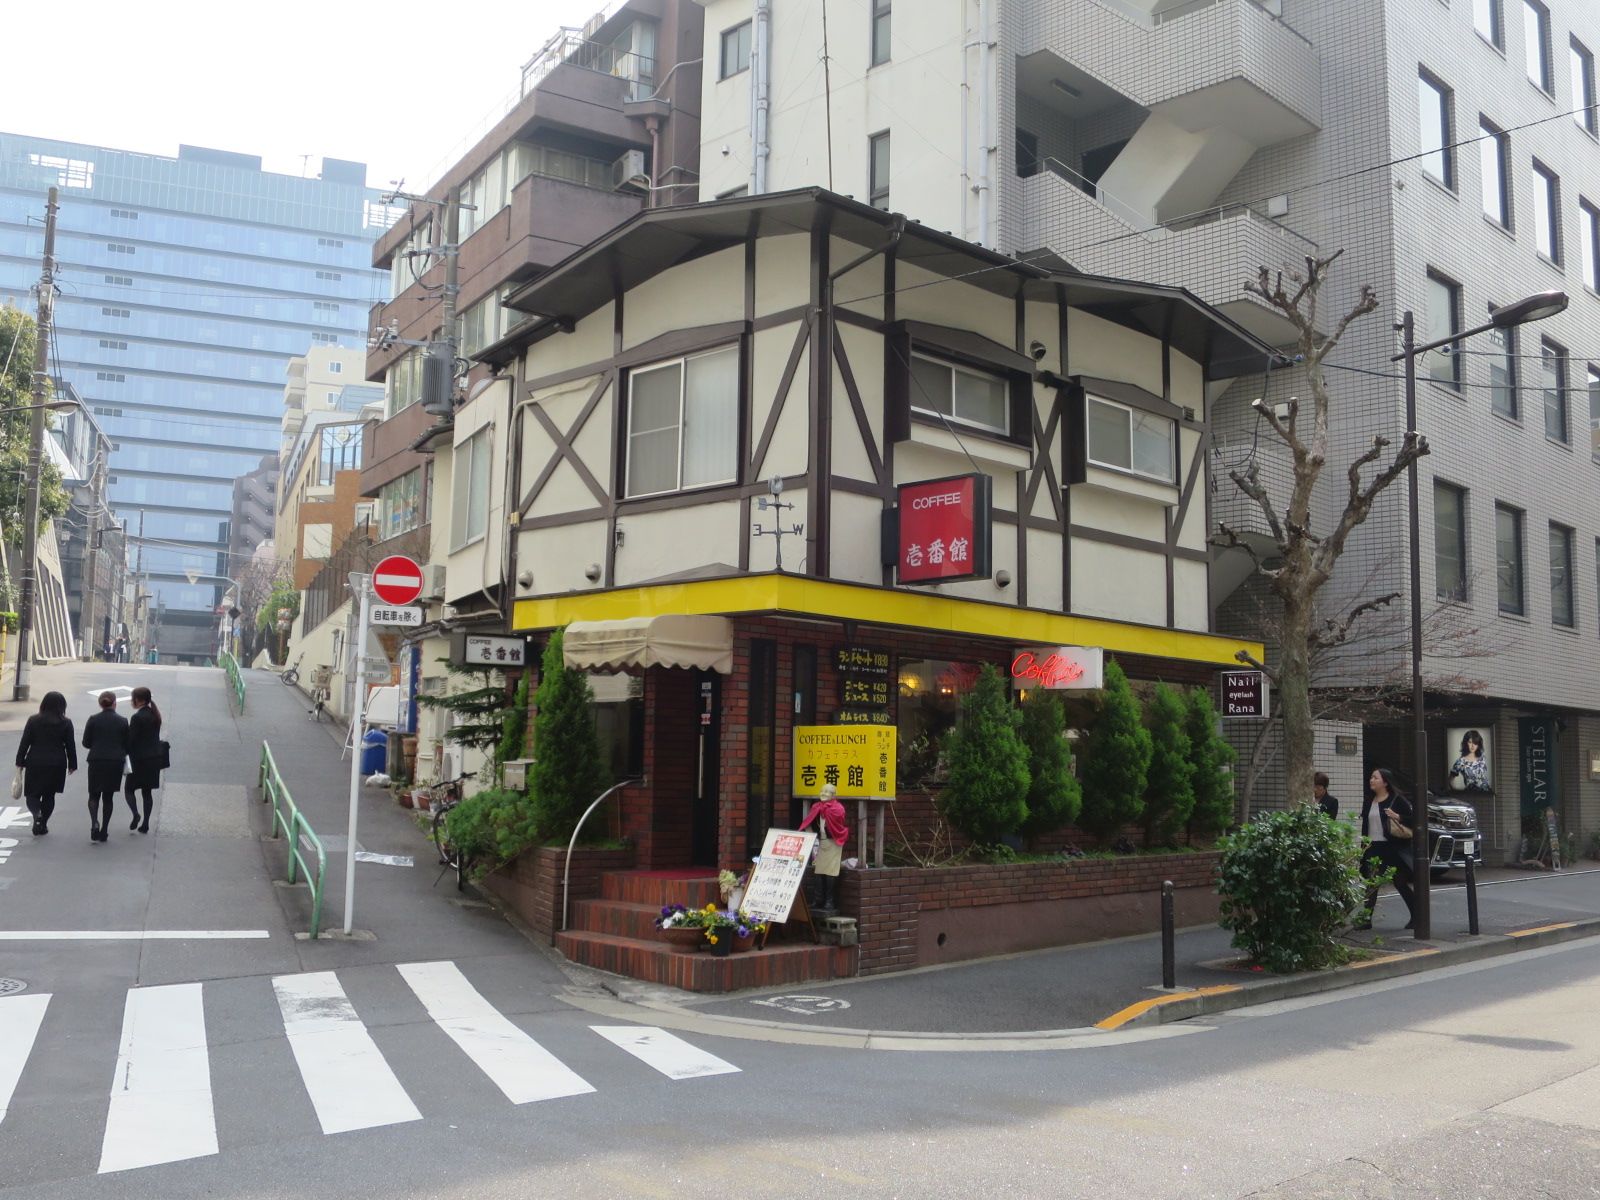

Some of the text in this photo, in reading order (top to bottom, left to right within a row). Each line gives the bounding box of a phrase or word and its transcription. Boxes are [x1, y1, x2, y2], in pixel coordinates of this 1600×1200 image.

[912, 492, 961, 510] COFFEE
[906, 537, 968, 567] 壱番館
[374, 610, 417, 622] 自転車を除く
[481, 646, 521, 661] 壱番館
[845, 681, 869, 691] コーヒー
[1228, 677, 1254, 686] Nail
[845, 692, 869, 701] ジュース
[1229, 691, 1254, 700] eyelash
[1228, 703, 1255, 713] Rana
[799, 735, 832, 745] COFFEE
[836, 734, 867, 745] LUNCH
[808, 750, 858, 760] カフェテラス
[1531, 726, 1547, 802] STELLAR
[801, 764, 864, 787] 壱番館
[879, 752, 888, 792] 壱番館
